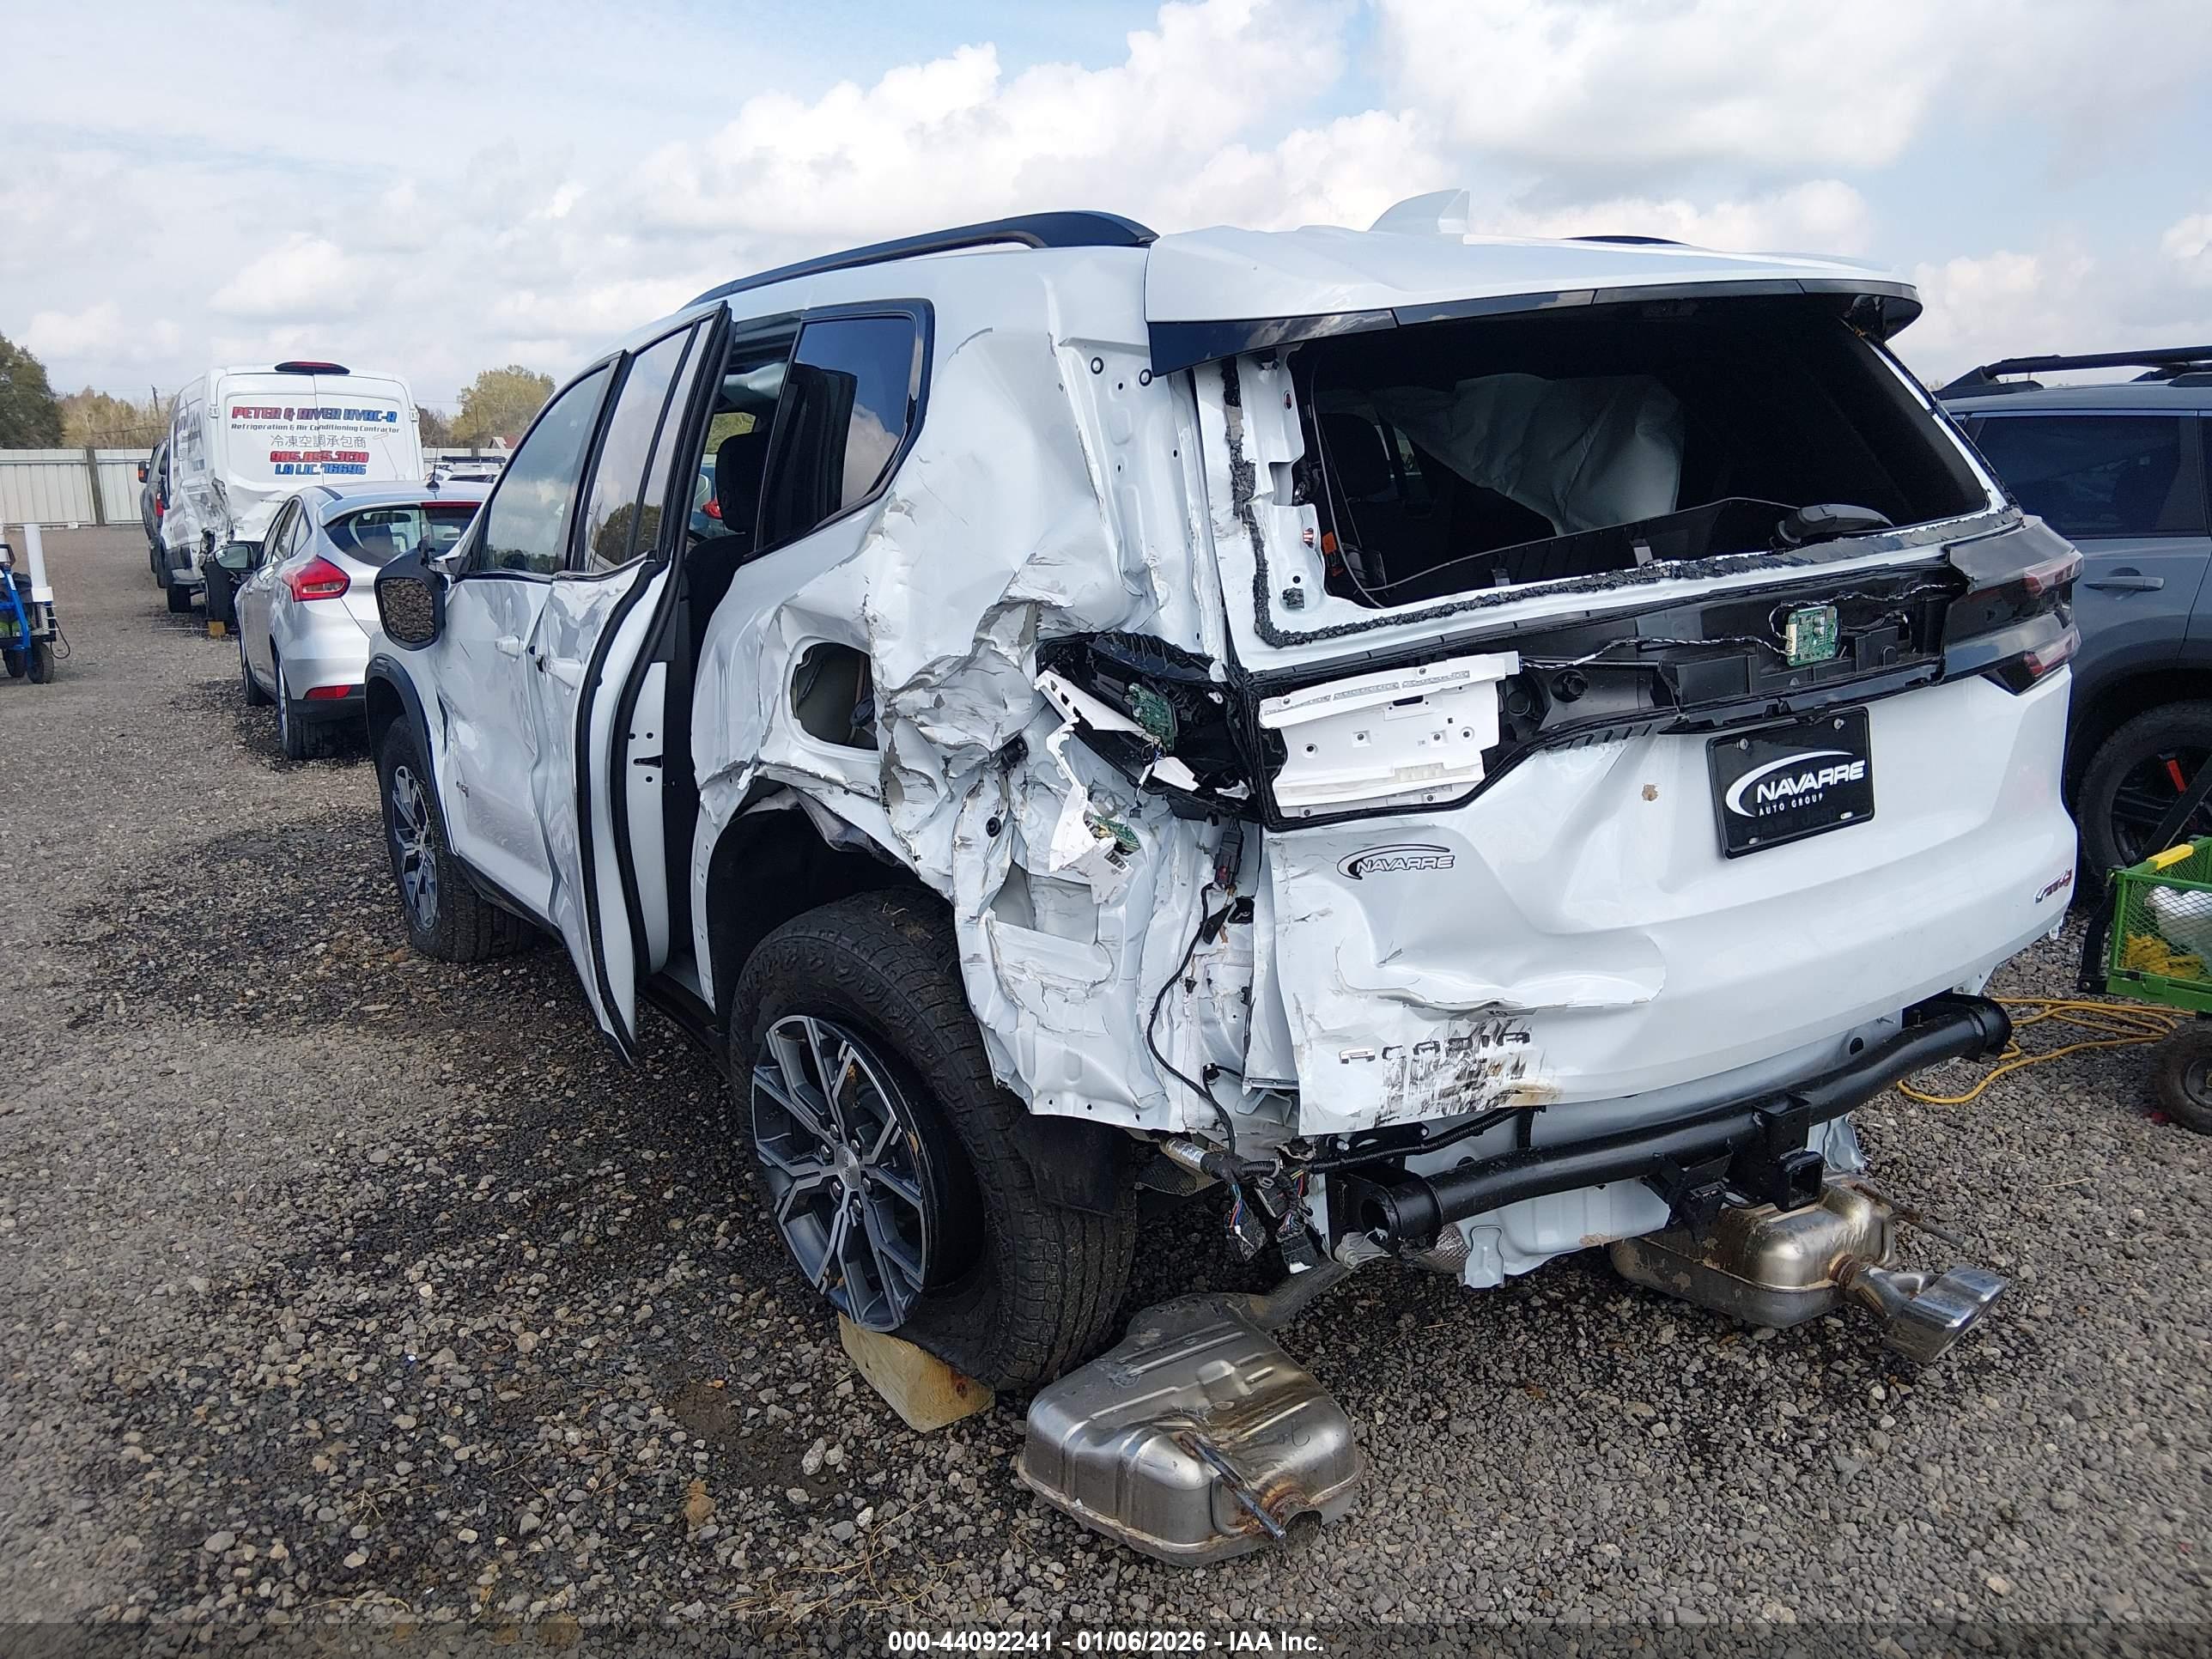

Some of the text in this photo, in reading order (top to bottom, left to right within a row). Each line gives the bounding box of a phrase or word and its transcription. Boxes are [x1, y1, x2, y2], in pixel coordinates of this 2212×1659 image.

[232, 407, 397, 422] PETER & RIVER HVAC-R
[310, 423, 358, 432] Conditioning
[270, 434, 366, 448] 冷凍空調承包商
[275, 464, 294, 475] LA
[295, 464, 320, 475] LIC.
[1757, 760, 1865, 803] NAVARRE
[1759, 793, 1824, 817] AUTO GROUP
[1356, 855, 1455, 872] NAVARRE
